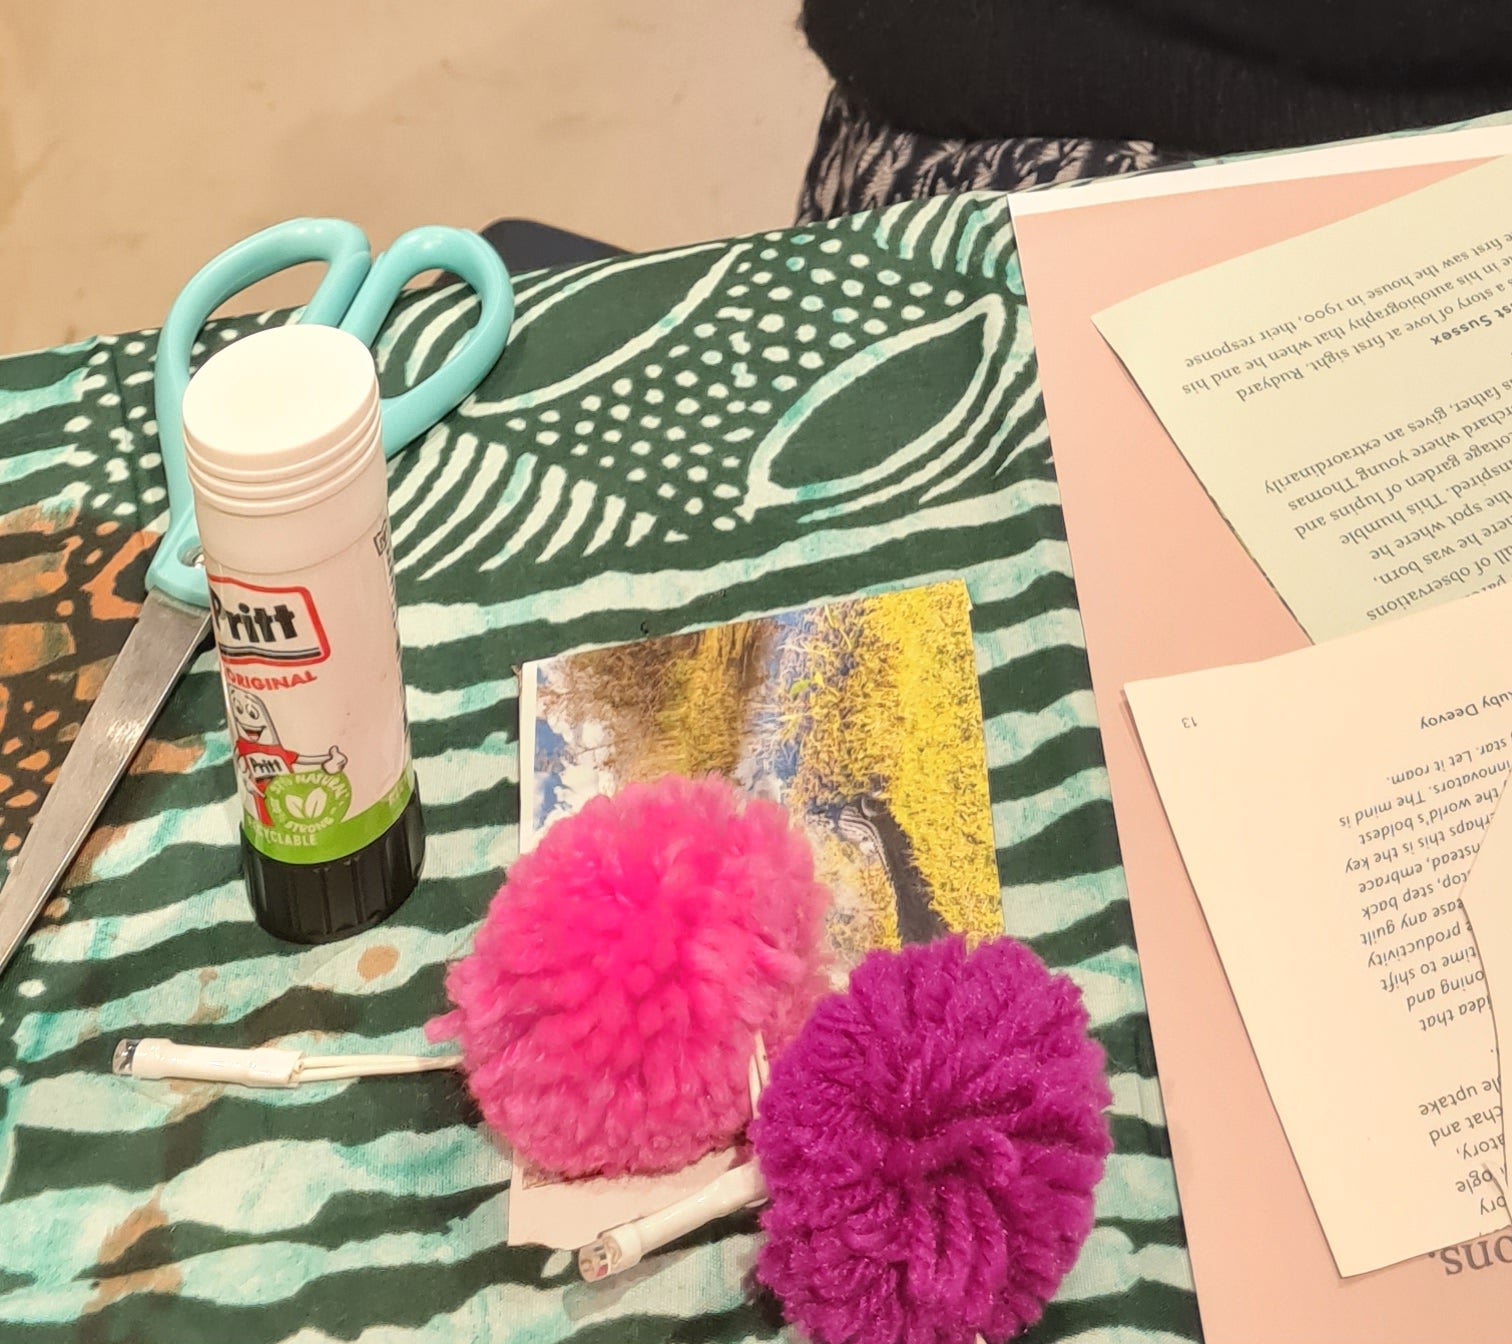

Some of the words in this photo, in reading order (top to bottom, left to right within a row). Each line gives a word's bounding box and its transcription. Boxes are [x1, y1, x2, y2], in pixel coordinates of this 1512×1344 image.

[1470, 237, 1504, 257] first
[1441, 251, 1470, 269] saw
[1481, 262, 1502, 275] in
[1413, 264, 1440, 280] the
[1455, 270, 1484, 286] his
[1365, 275, 1415, 300] house
[1495, 283, 1506, 293] a
[1345, 294, 1367, 307] in
[1348, 281, 1455, 332] autobiography
[1457, 288, 1494, 311] story
[1297, 302, 1345, 324] 1900,
[1404, 312, 1440, 332] love
[1437, 305, 1454, 323] of
[1258, 321, 1298, 341] their
[1312, 326, 1347, 345] that
[1385, 327, 1403, 341] at
[1429, 314, 1493, 346] Sussex
[1184, 335, 1257, 368] response
[1266, 340, 1313, 362] when
[1351, 334, 1386, 355] first
[1244, 356, 1268, 371] he
[1305, 348, 1351, 372] sight.
[1181, 377, 1211, 395] his
[1209, 365, 1242, 387] and
[1235, 367, 1305, 403] Rudyard
[1448, 385, 1502, 413] father,
[1406, 406, 1448, 433] gives
[1382, 427, 1406, 442] an
[1264, 438, 1381, 495] extraordinarily
[225, 667, 318, 691] ORIGINAL
[1181, 716, 1198, 729] 13
[1420, 703, 1480, 730] Deevoy
[1475, 737, 1508, 756] star.
[249, 756, 283, 774] Pritt
[1433, 759, 1447, 773] it
[1447, 749, 1473, 767] Let
[1386, 764, 1430, 785] roam.
[1424, 759, 1512, 796] innovators.
[1395, 790, 1427, 807] The
[1472, 786, 1500, 807] the
[1338, 815, 1352, 829] is
[1354, 800, 1393, 827] mind
[1416, 797, 1472, 827] world's
[284, 816, 335, 833] STRONG
[1358, 817, 1415, 846] boldest
[1438, 945, 1478, 969] time
[1419, 960, 1438, 975] to
[1379, 967, 1416, 993] shift
